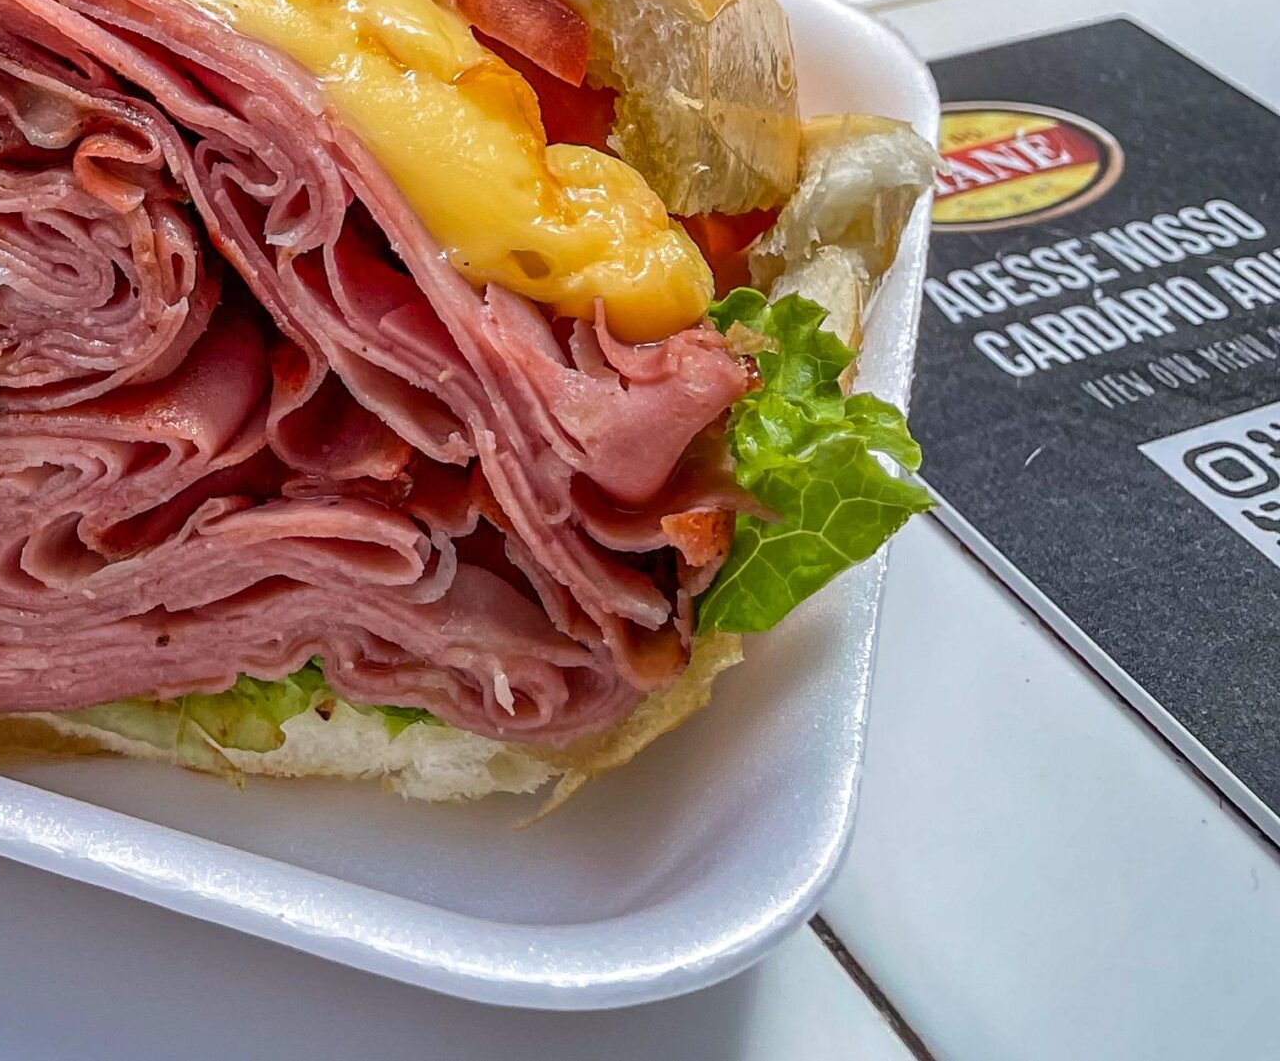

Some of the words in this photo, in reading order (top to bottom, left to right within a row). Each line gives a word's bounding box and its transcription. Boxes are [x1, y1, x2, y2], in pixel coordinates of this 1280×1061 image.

[923, 238, 1120, 325] ACESSE
[1090, 198, 1267, 273] NOSSO
[973, 288, 1229, 377] CARDÁPIO
[1080, 369, 1155, 409] VIEW
[1147, 352, 1211, 389] OUR
[1196, 333, 1277, 374] MENU
